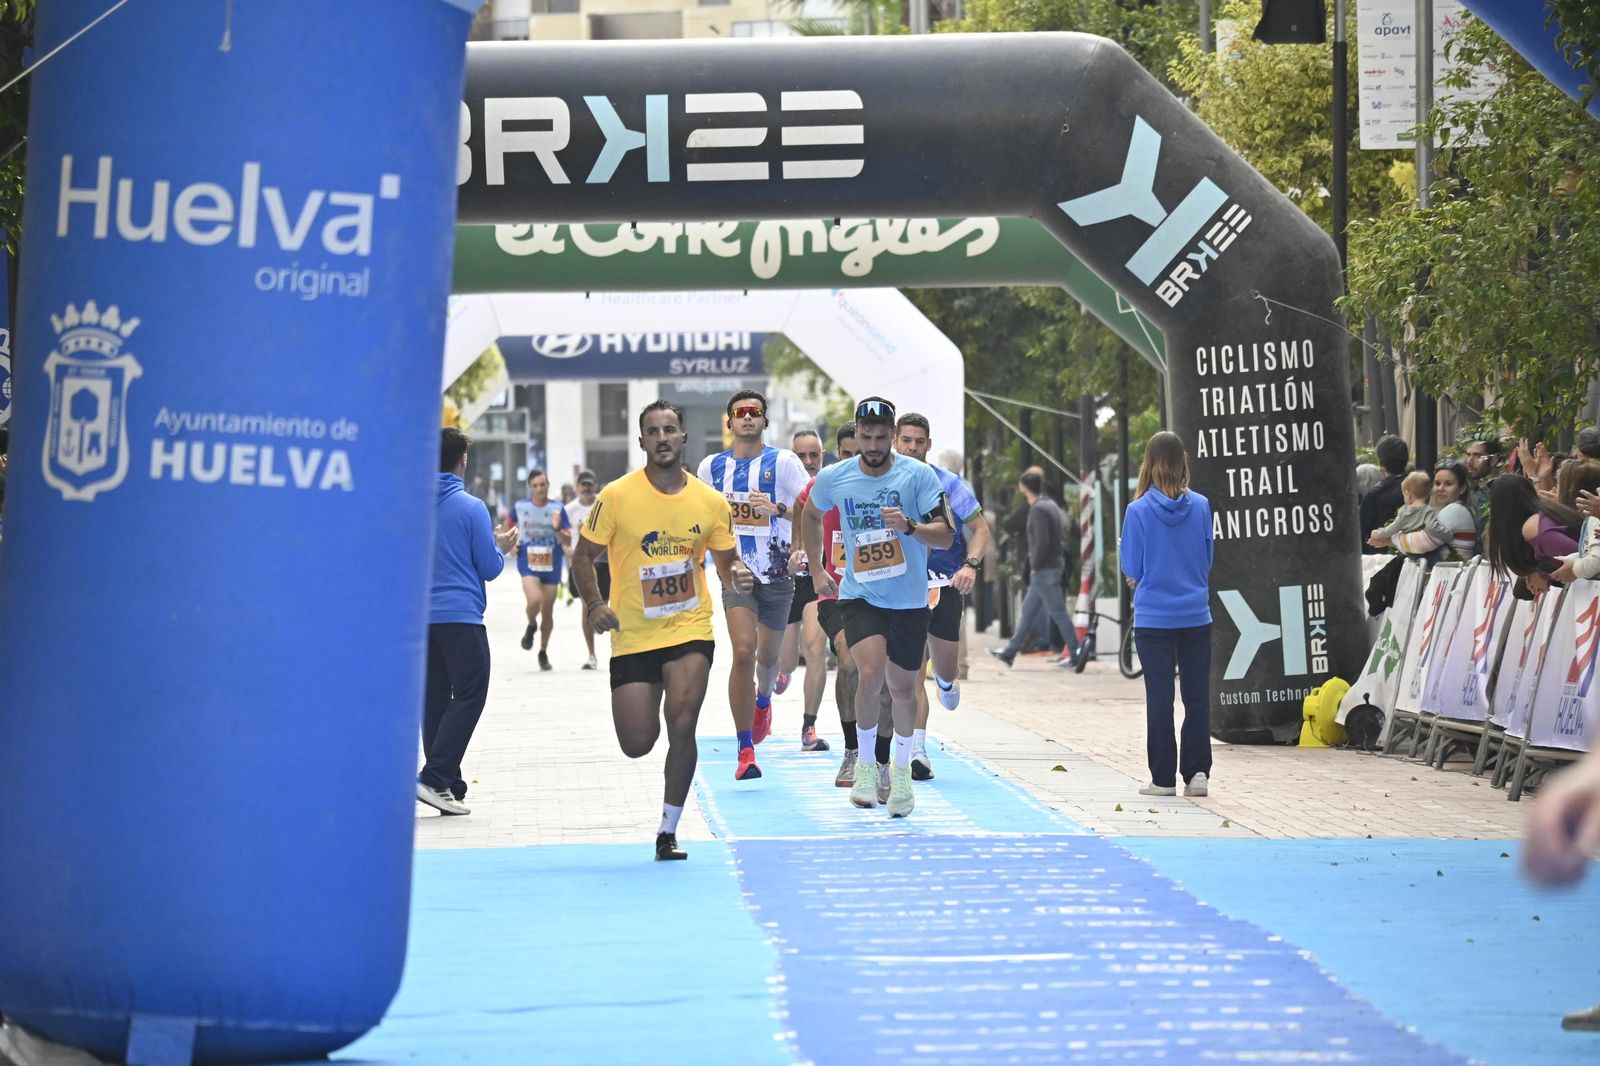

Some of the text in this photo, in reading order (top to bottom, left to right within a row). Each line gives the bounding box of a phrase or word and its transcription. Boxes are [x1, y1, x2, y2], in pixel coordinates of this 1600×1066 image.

[1374, 25, 1411, 37] apavt
[57, 154, 376, 256] Huelva
[255, 261, 370, 299] original
[669, 356, 751, 375] SYRLUZ
[1196, 339, 1315, 376] CICLISMO
[1200, 376, 1315, 417] TRIATLÓN
[154, 406, 327, 438] Ayuntamiento
[330, 417, 359, 442] de
[1197, 421, 1325, 458] ATLETISMO
[150, 438, 355, 492] HUELVA
[1226, 464, 1299, 497] TRAIL
[1212, 503, 1334, 540] ANICROSS
[859, 541, 896, 564] 559
[642, 566, 656, 577] 2K
[651, 573, 689, 598] 480
[868, 567, 892, 577] Huelva
[1220, 691, 1261, 705] Custom
